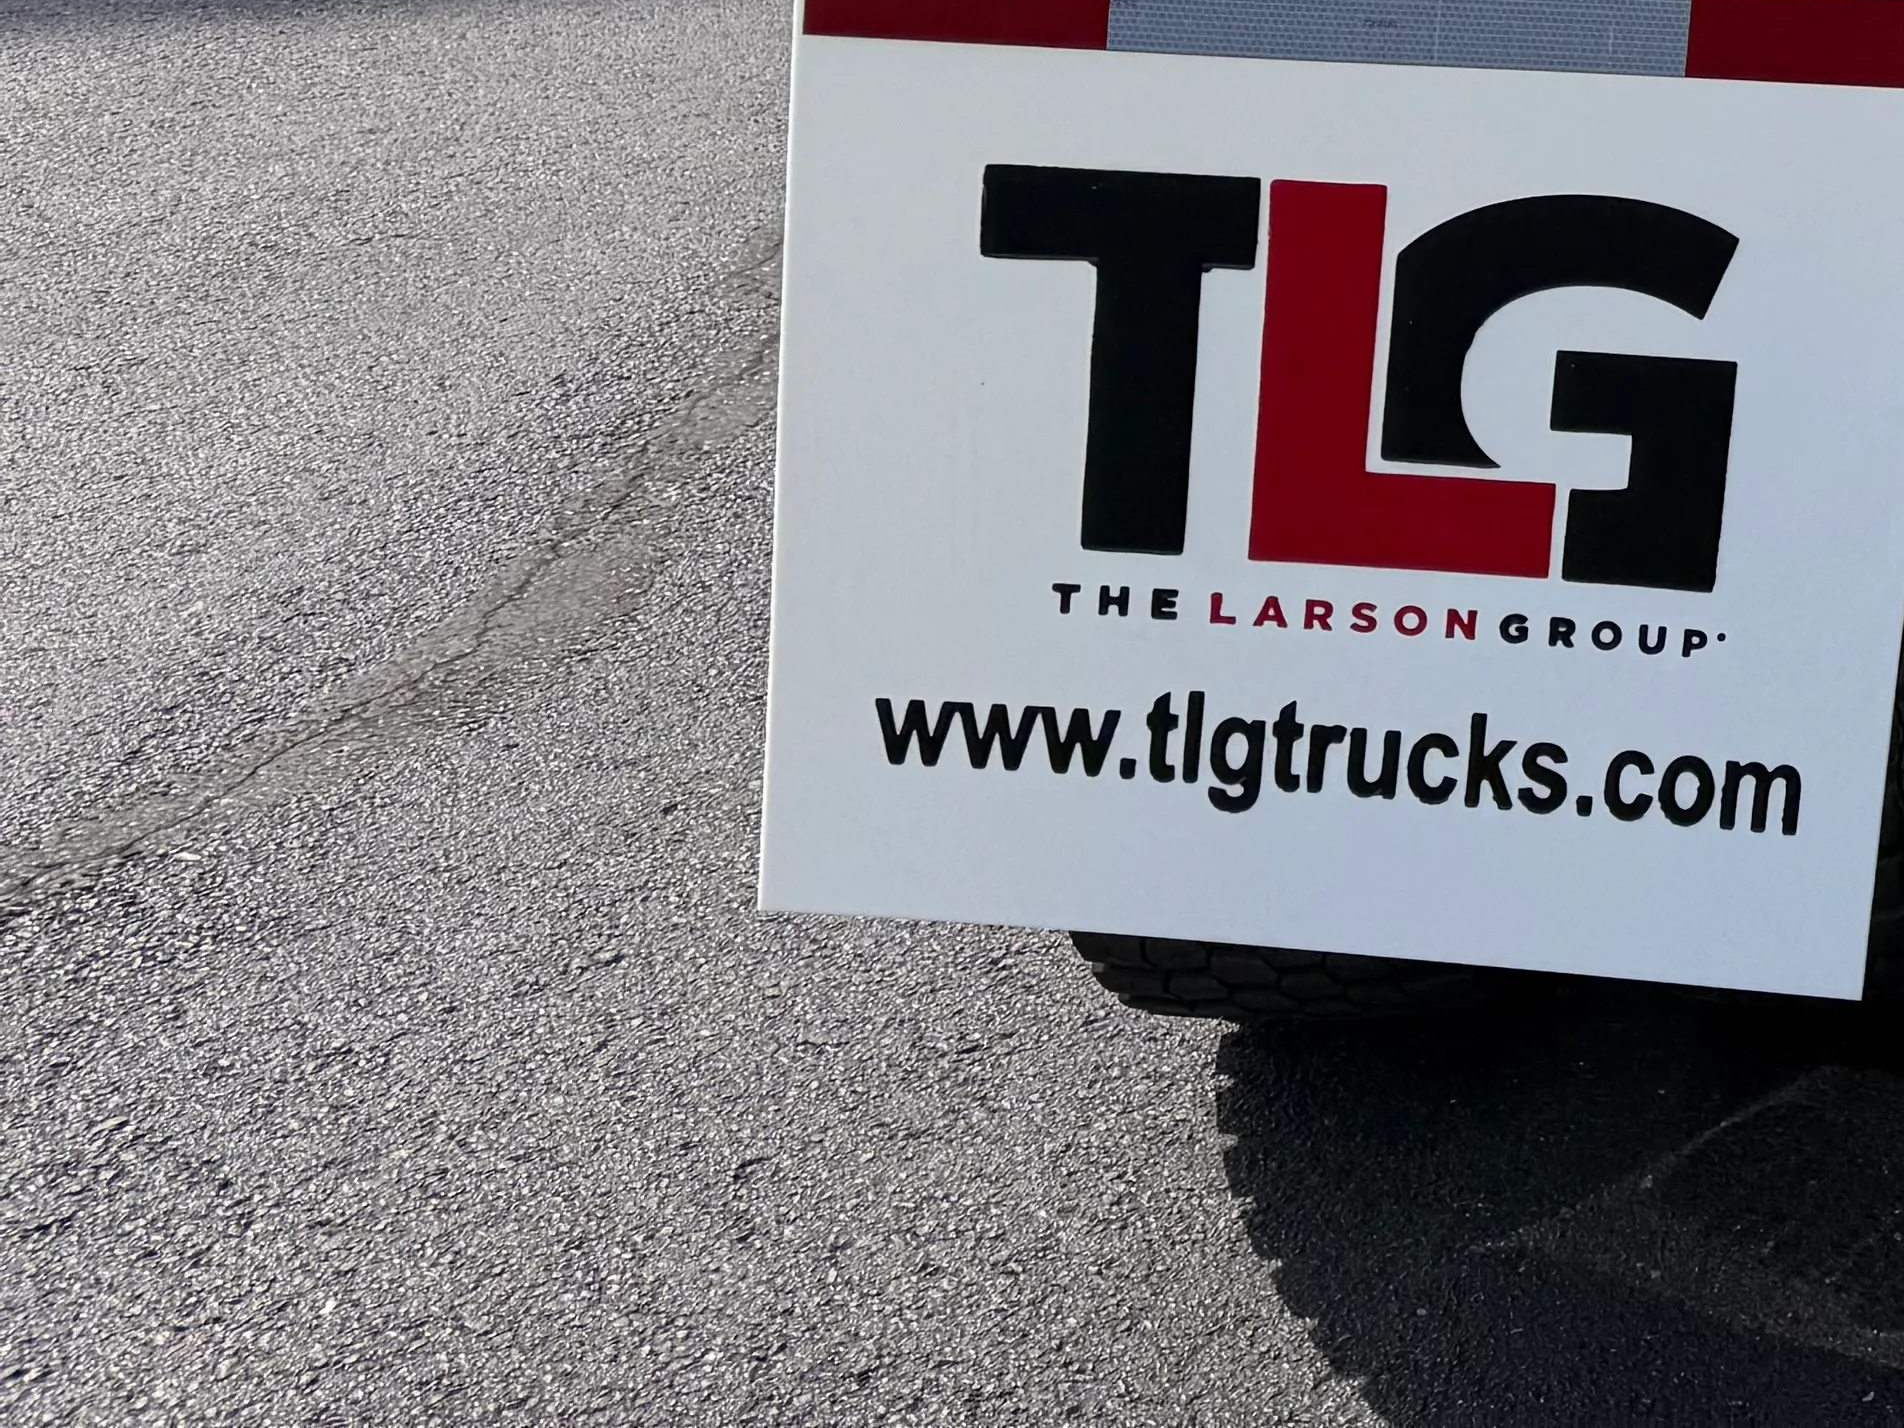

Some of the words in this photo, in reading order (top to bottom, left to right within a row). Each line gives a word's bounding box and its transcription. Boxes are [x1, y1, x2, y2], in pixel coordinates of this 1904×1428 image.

[980, 164, 1740, 593] TLG
[1051, 582, 1180, 621] THE
[1208, 591, 1479, 642] LARSON
[1499, 611, 1708, 659] GROUP
[874, 690, 1802, 838] www.tlgtrucks.com
